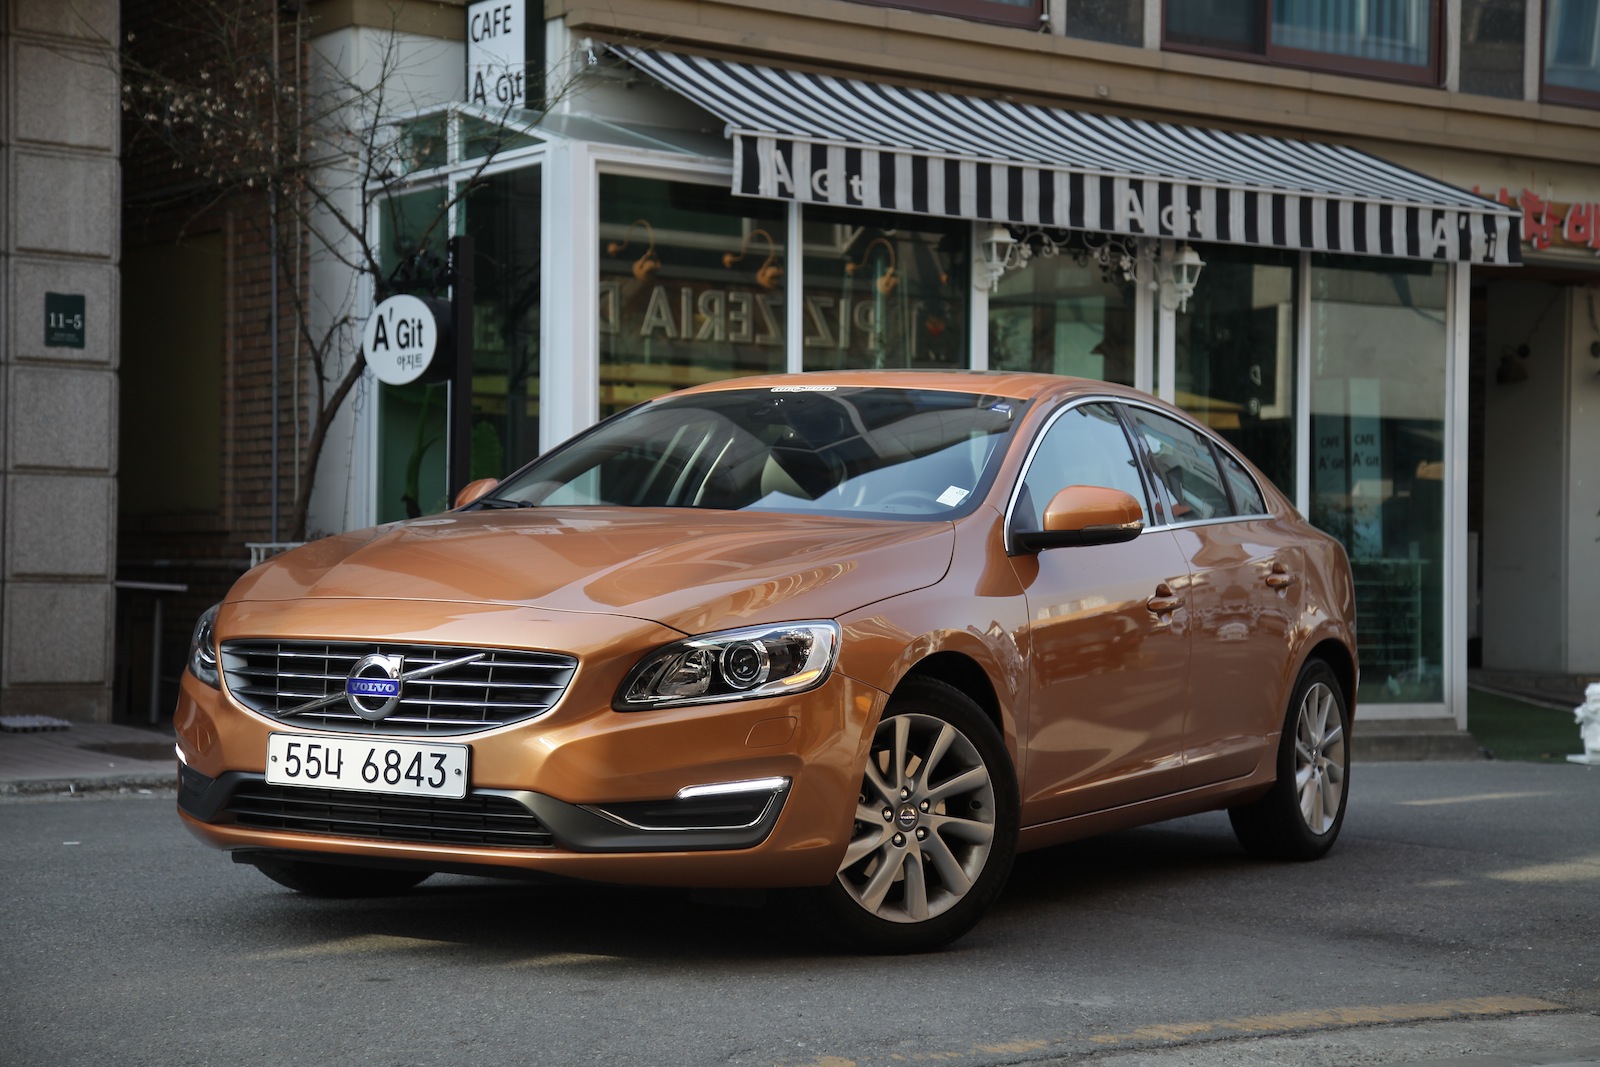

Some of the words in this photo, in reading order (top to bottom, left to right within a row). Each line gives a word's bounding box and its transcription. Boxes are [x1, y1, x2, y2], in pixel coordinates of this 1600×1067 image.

[471, 5, 511, 42] CAFE
[50, 312, 82, 330] 11-5
[397, 353, 423, 371] 아지트
[1354, 433, 1375, 446] CAFE
[351, 682, 396, 693] VOLVO
[285, 742, 344, 779] 55나
[361, 748, 447, 789] 6843
